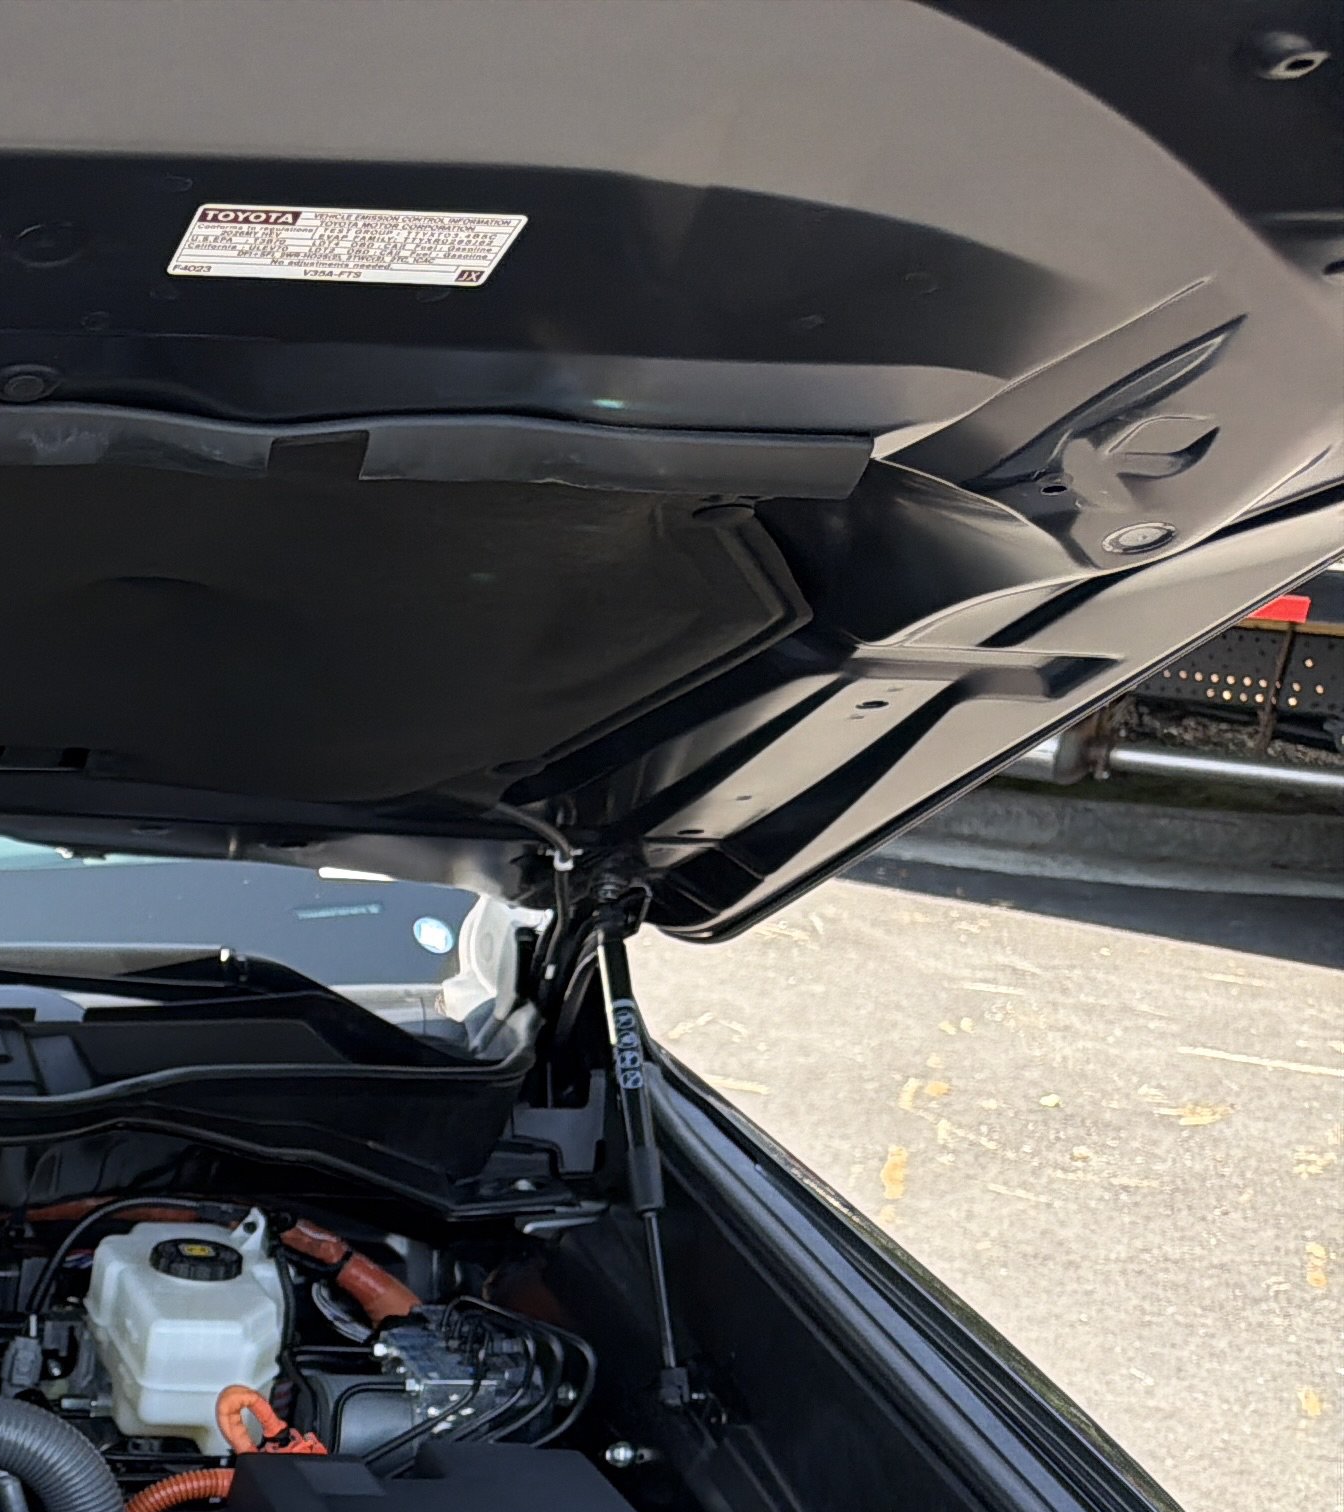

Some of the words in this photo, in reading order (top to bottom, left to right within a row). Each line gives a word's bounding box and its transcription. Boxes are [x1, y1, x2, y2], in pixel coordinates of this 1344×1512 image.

[204, 210, 294, 223] TOYOTA
[355, 214, 400, 222] EMISSION
[448, 217, 511, 226] INFORMATION
[259, 226, 313, 234] regulations
[319, 220, 359, 228] TOYOTA
[401, 223, 476, 232] CORPORATION
[187, 242, 238, 250] California
[287, 260, 349, 269] adjustments
